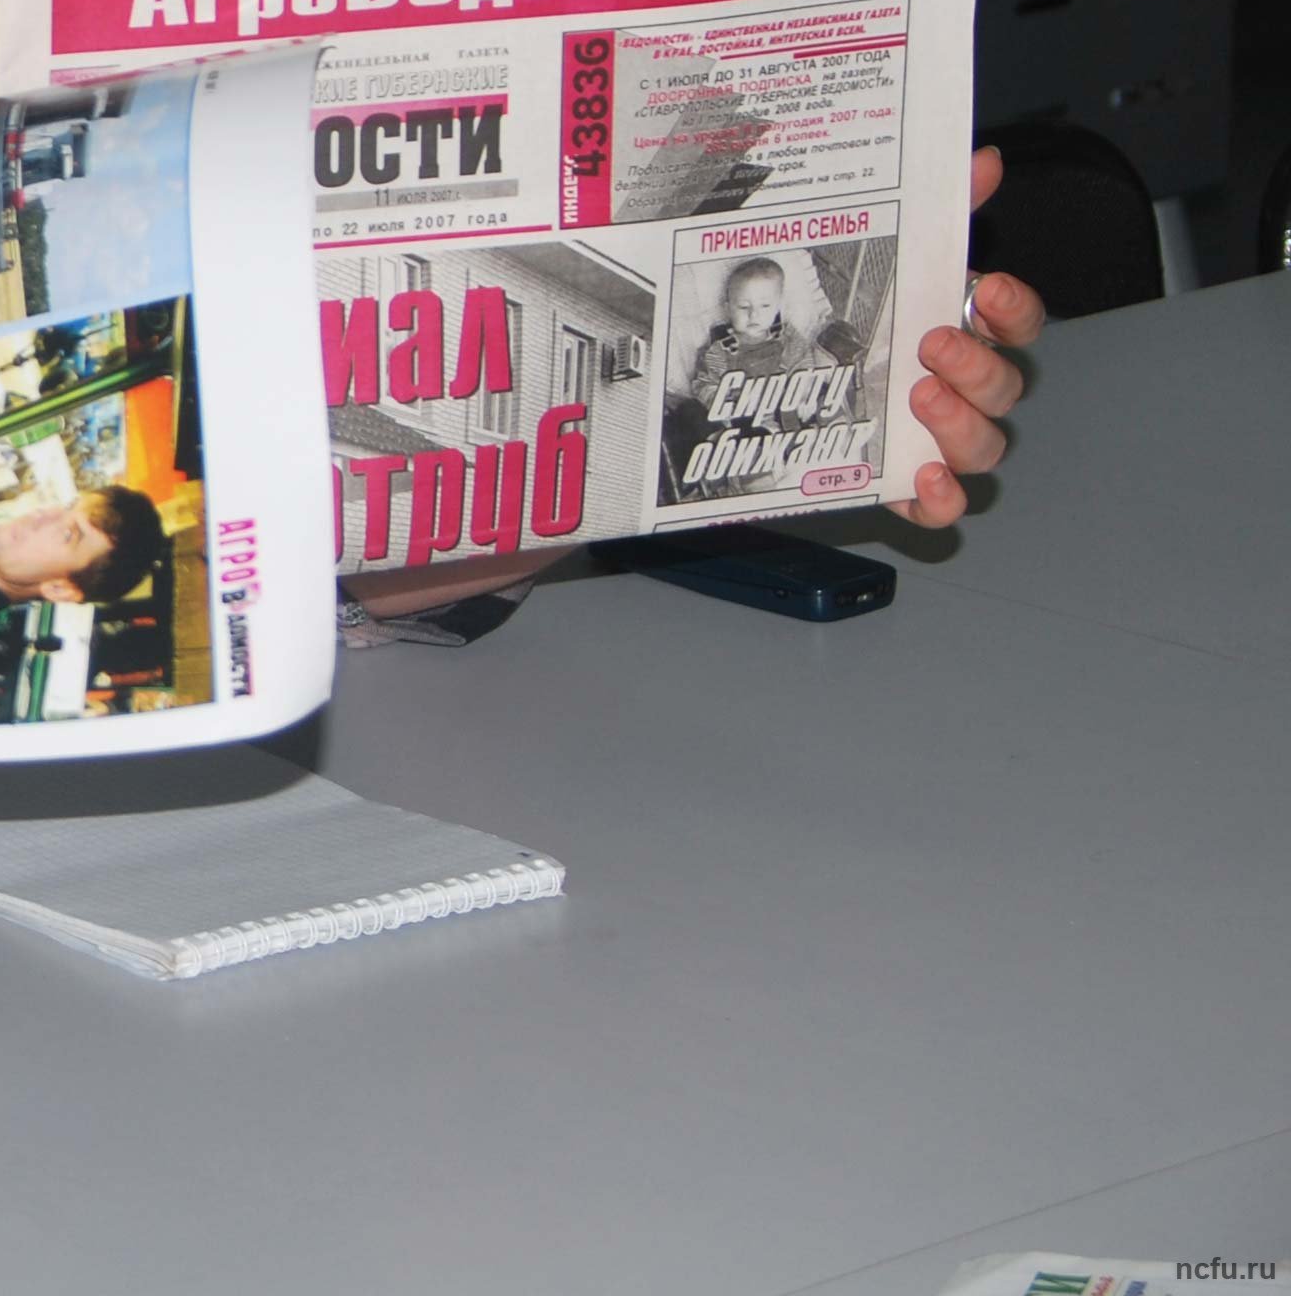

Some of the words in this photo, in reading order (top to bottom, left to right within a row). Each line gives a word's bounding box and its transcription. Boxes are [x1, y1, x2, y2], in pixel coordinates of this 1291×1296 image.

[785, 10, 863, 31] НЕЗАВИСИМАЯ
[864, 6, 902, 22] ГАЗЕТА
[457, 46, 510, 60] ГАЗЕТА
[768, 29, 835, 47] ИНТЕРЕСНАЯ
[365, 64, 509, 100] ГУБЕРНСКИЕ
[668, 72, 710, 89] ИЮЛЯ
[713, 69, 735, 85] ДО
[738, 66, 753, 80] 31
[757, 58, 817, 78] АВГУСТА
[821, 54, 851, 70] 2007
[854, 49, 892, 66] ГОДА
[738, 74, 813, 95] ПОДПИСКА
[570, 36, 611, 178] 43836
[747, 85, 819, 105] ГУБЕРНСКИЕ
[829, 110, 858, 124] 2007
[313, 104, 505, 188] ОСТИ
[372, 188, 391, 208] 11
[430, 189, 454, 204] 2007
[312, 226, 333, 238] по
[342, 222, 359, 236] 22
[414, 214, 456, 230] 2007
[467, 210, 509, 226] года
[700, 219, 803, 254] ПРИЕМНАЯ
[806, 210, 870, 240] СЕМЬЯ
[319, 285, 514, 408] иал
[707, 364, 856, 429] Сироту
[681, 419, 877, 484] обижают
[331, 401, 588, 567] труб
[818, 472, 848, 491] стр.
[853, 468, 863, 482] 9
